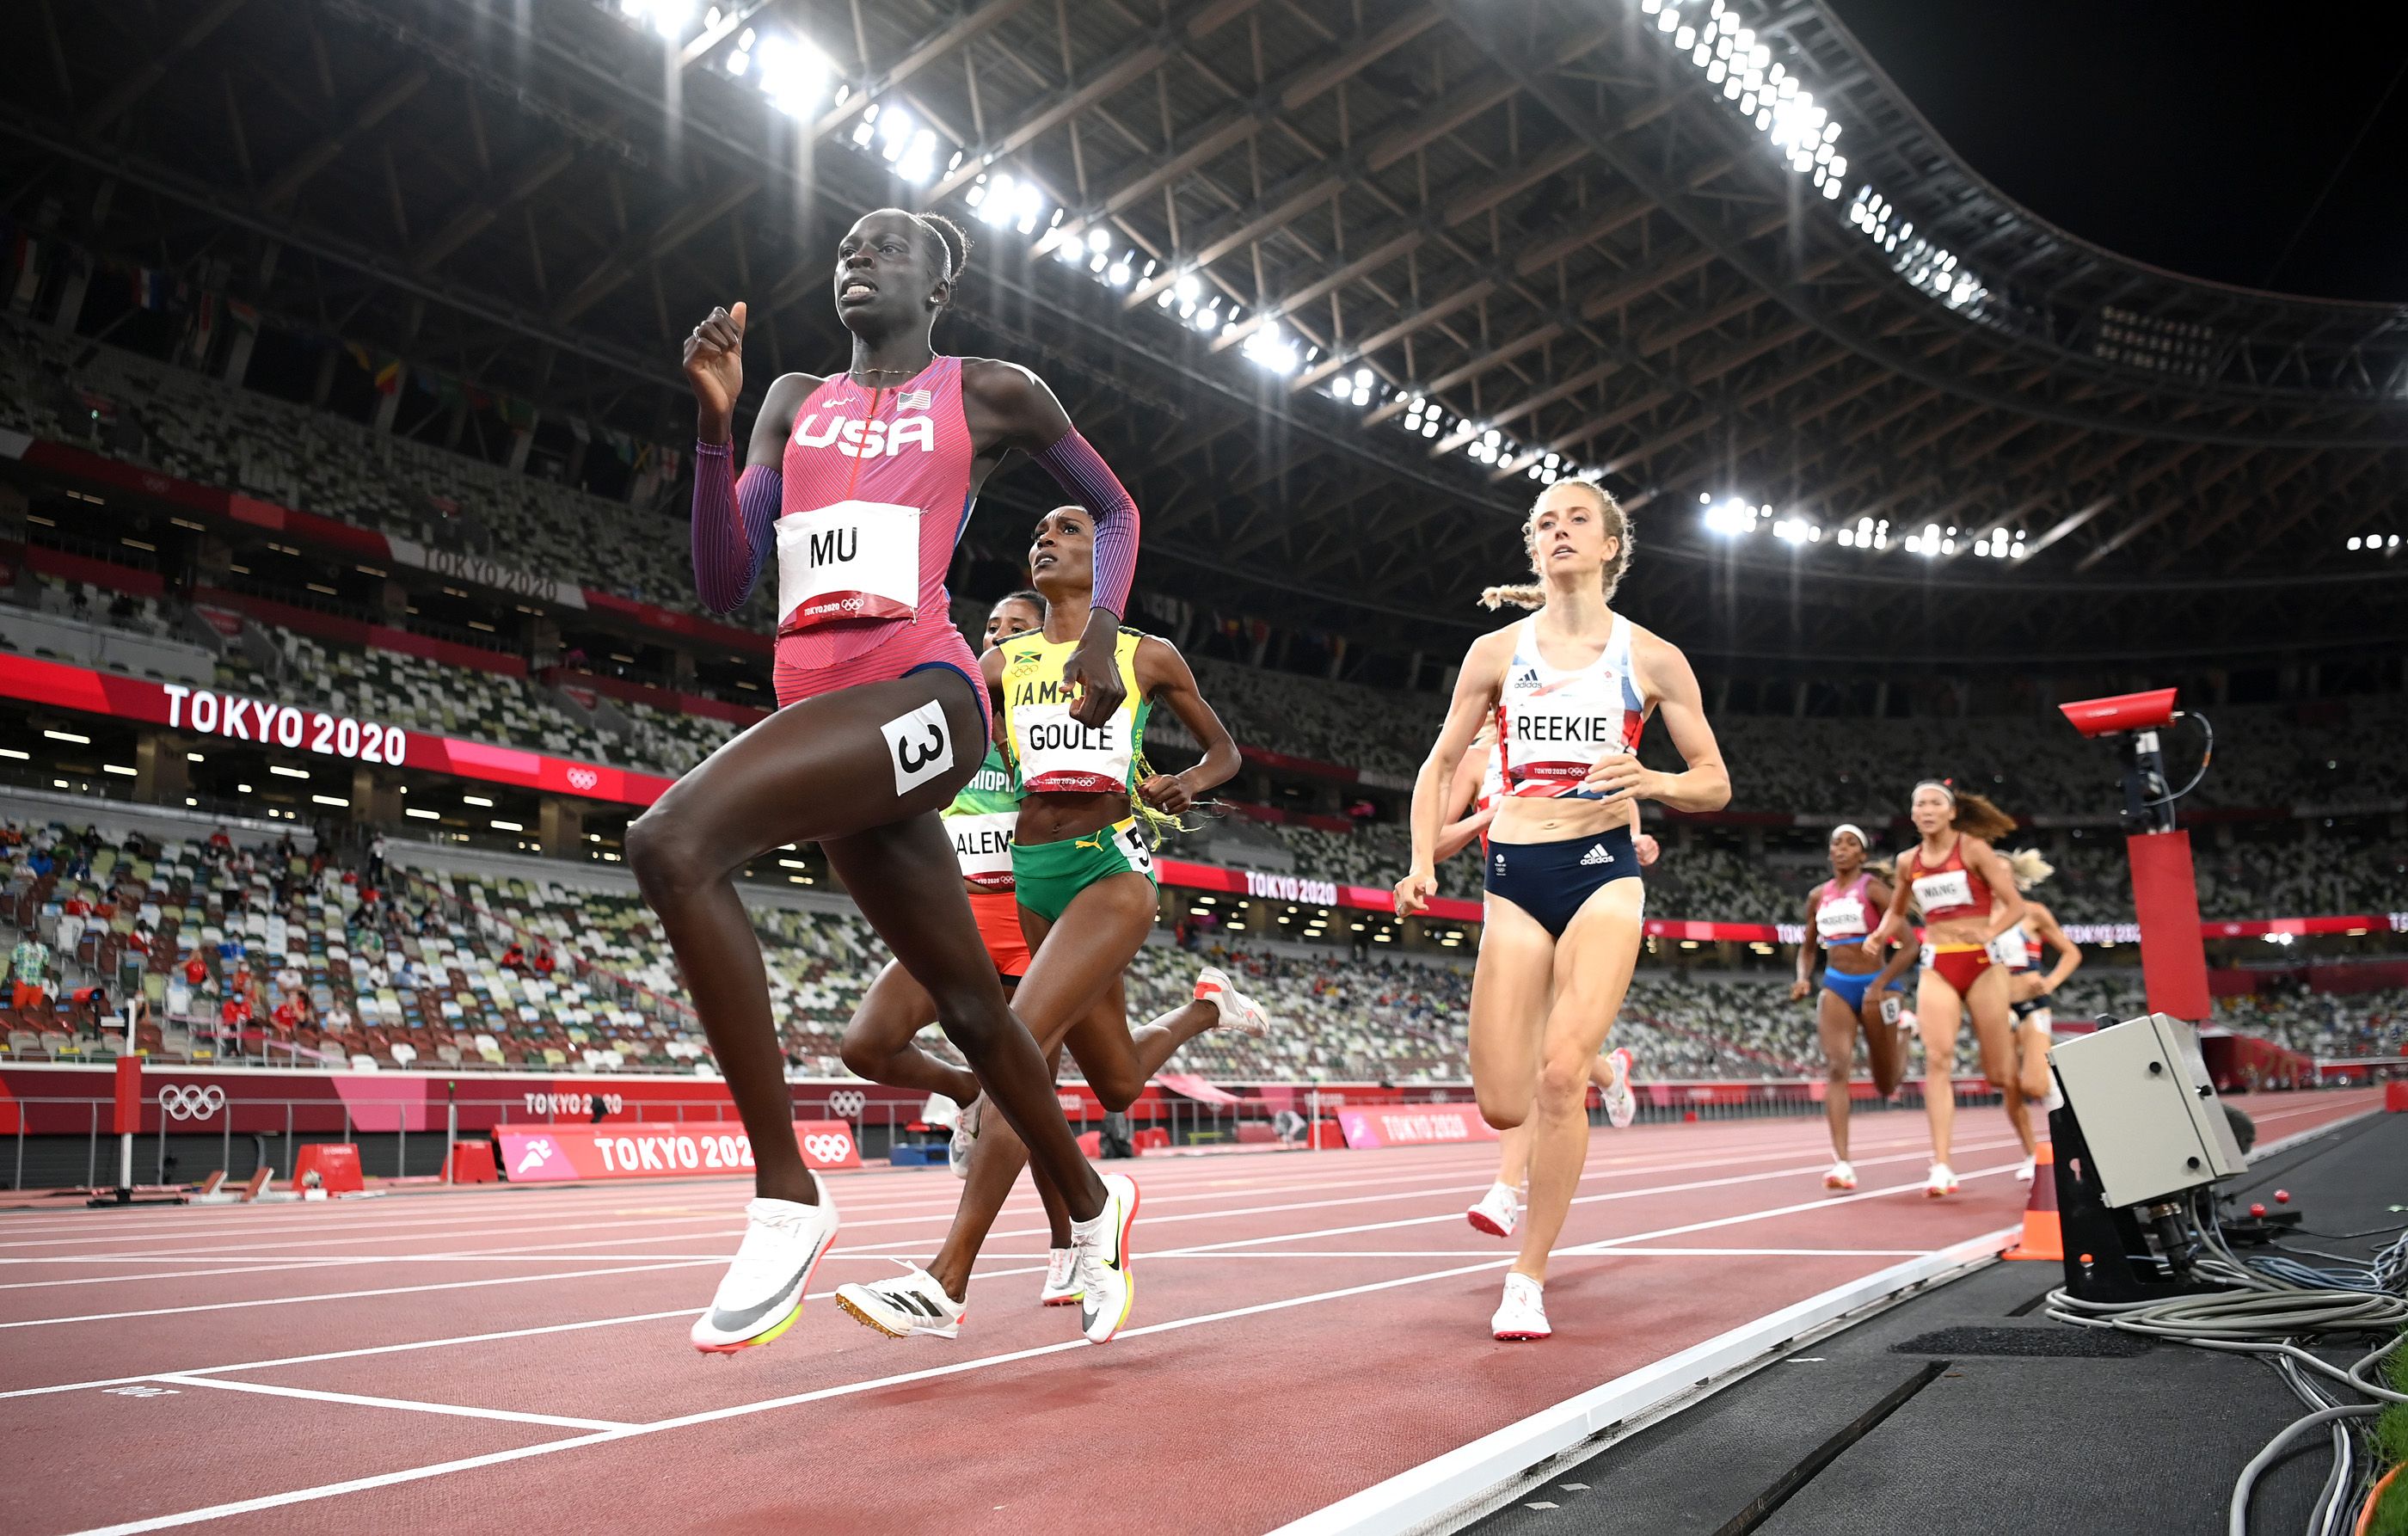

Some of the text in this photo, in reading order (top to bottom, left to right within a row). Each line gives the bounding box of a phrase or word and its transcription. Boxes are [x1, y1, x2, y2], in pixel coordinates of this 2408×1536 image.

[794, 414, 935, 458] USA
[810, 527, 857, 568] MU
[424, 545, 558, 601] TOKYO 2020
[804, 602, 840, 617] TOKYO 2020
[1011, 680, 1086, 710] JAMA
[163, 683, 406, 766] TOKYO 2020
[1029, 723, 1114, 751] GOULE
[1518, 716, 1606, 741] REEKIE
[899, 724, 944, 773] 3
[968, 770, 1014, 792] HIOPI
[1126, 826, 1149, 867] 5
[1580, 856, 1615, 866] adidas
[1245, 870, 1337, 906] TOKYO 2020
[1925, 883, 1956, 897] WANG
[524, 1093, 623, 1115] TOKYO 220
[1381, 1114, 1468, 1142] TOKYO 2020
[593, 1135, 757, 1171] TOKYO 202
